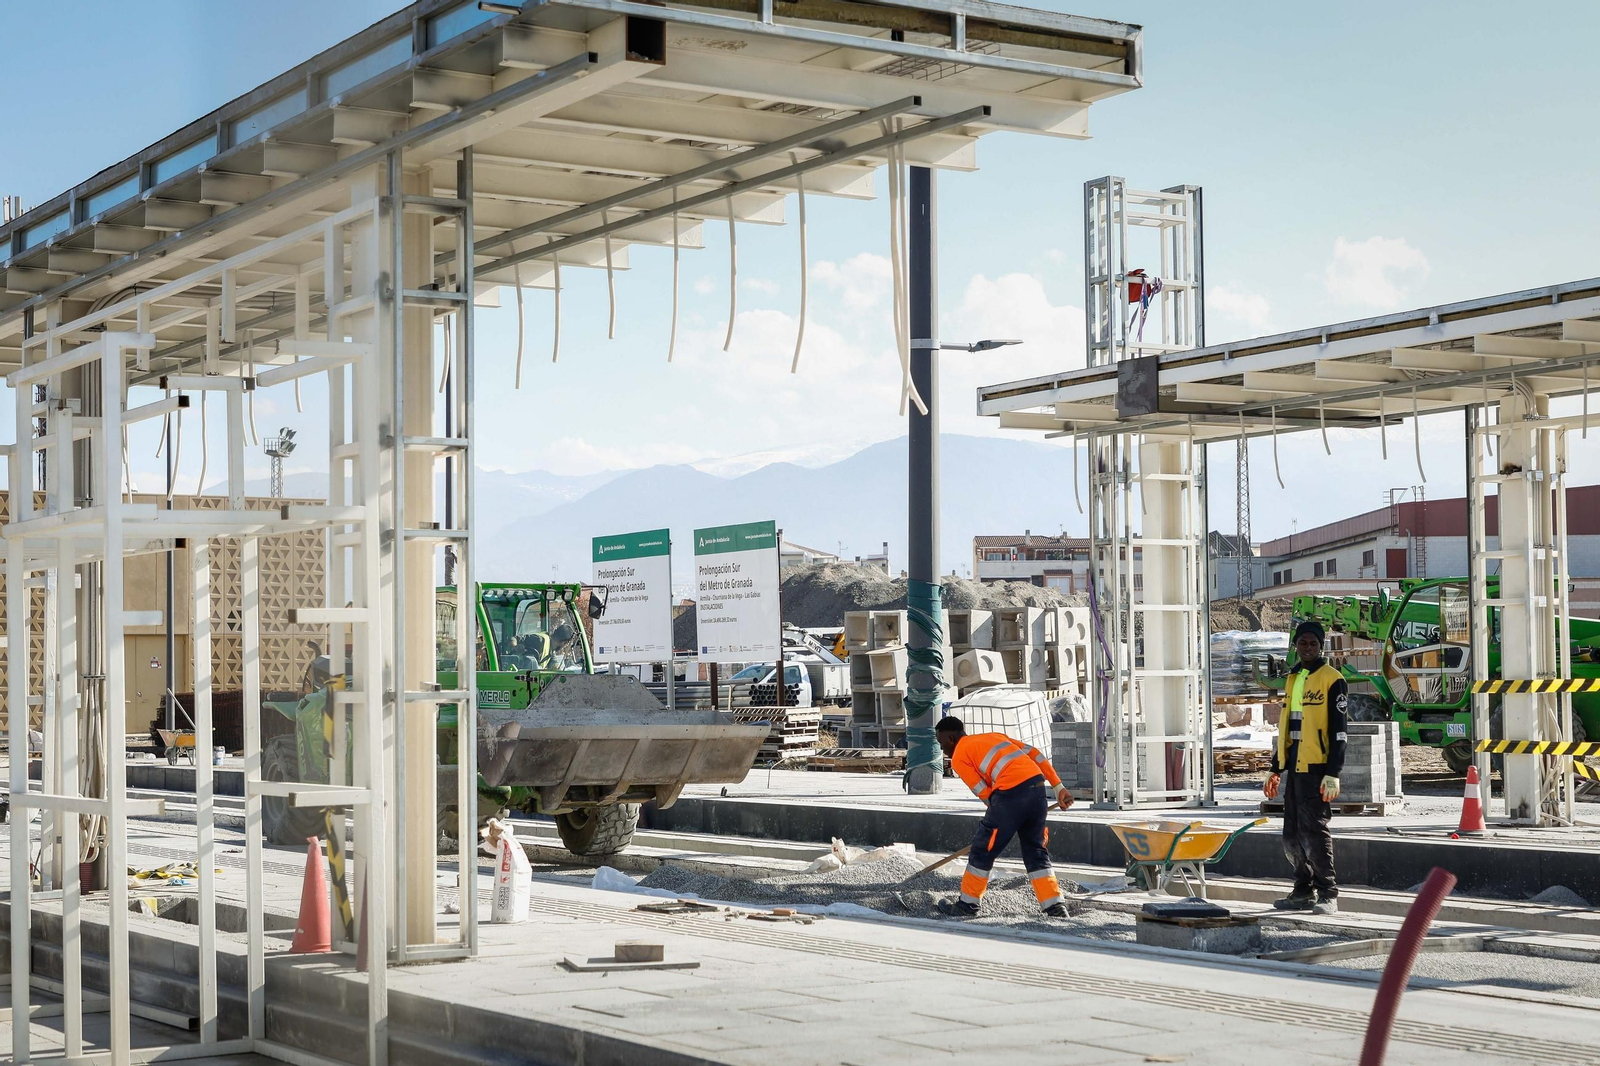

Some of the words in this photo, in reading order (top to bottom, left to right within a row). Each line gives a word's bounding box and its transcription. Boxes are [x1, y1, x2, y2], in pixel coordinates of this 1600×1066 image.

[598, 567, 626, 580] Prolongación
[627, 567, 635, 577] Sur
[699, 563, 731, 577] Prolongación
[732, 562, 741, 573] Sur
[620, 582, 626, 592] de
[626, 580, 645, 592] Granada
[699, 581, 707, 591] del
[708, 580, 723, 590] Metro
[724, 579, 730, 589] de
[731, 577, 753, 589] Granada
[480, 690, 510, 703] MERLO
